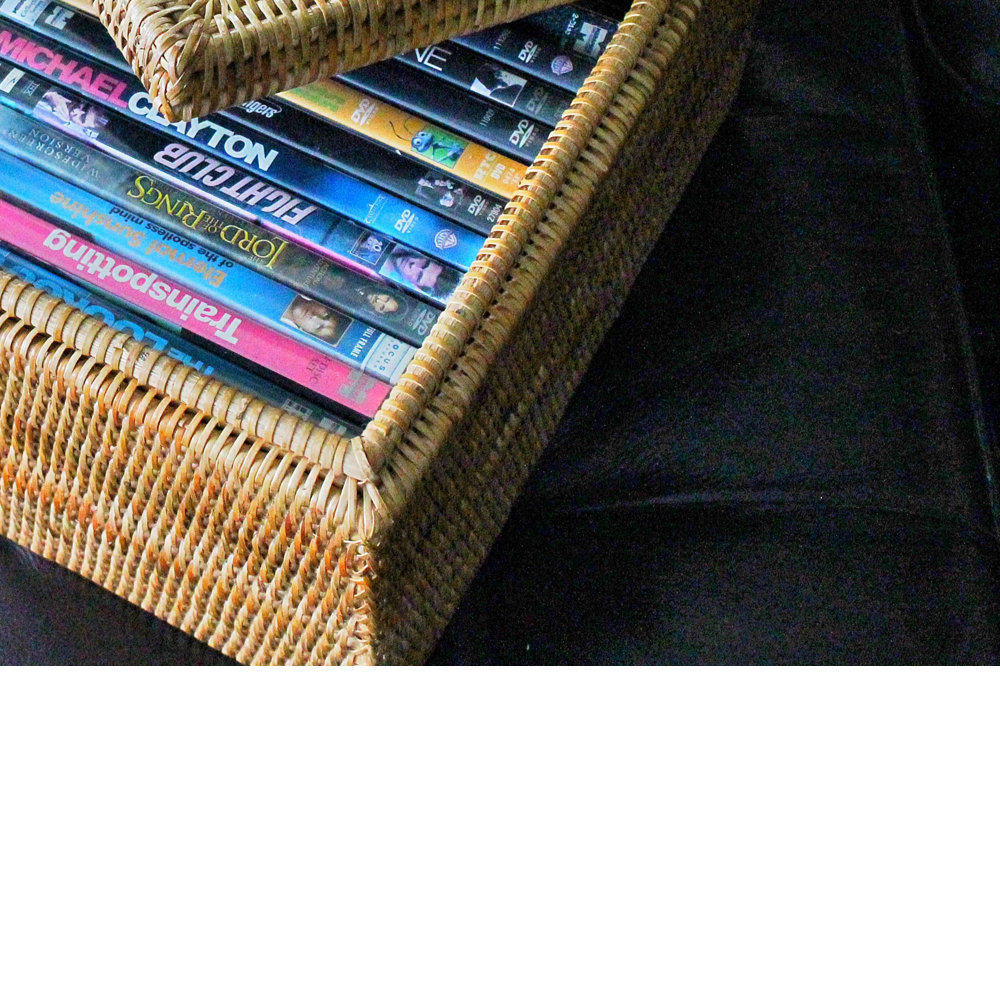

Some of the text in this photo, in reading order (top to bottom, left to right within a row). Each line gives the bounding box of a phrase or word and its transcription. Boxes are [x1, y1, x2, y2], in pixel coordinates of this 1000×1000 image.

[517, 38, 534, 61] DVD
[349, 95, 372, 124] DVD
[507, 116, 530, 146] DVD
[5, 125, 102, 181] WIDESCREEN
[25, 124, 93, 165] VERSION
[151, 134, 235, 194] CLUB
[46, 188, 146, 249] Sunshine
[124, 170, 209, 231] RINGS
[218, 163, 318, 232] FIGHT
[393, 207, 411, 231] DVD
[466, 193, 482, 214] DVD
[108, 203, 234, 271] of the spotless mind
[142, 234, 227, 288] Eternal
[215, 213, 289, 271] LORD
[38, 223, 249, 346] Trainspotting
[350, 336, 368, 358] FRAME
[414, 309, 436, 337] DVD
